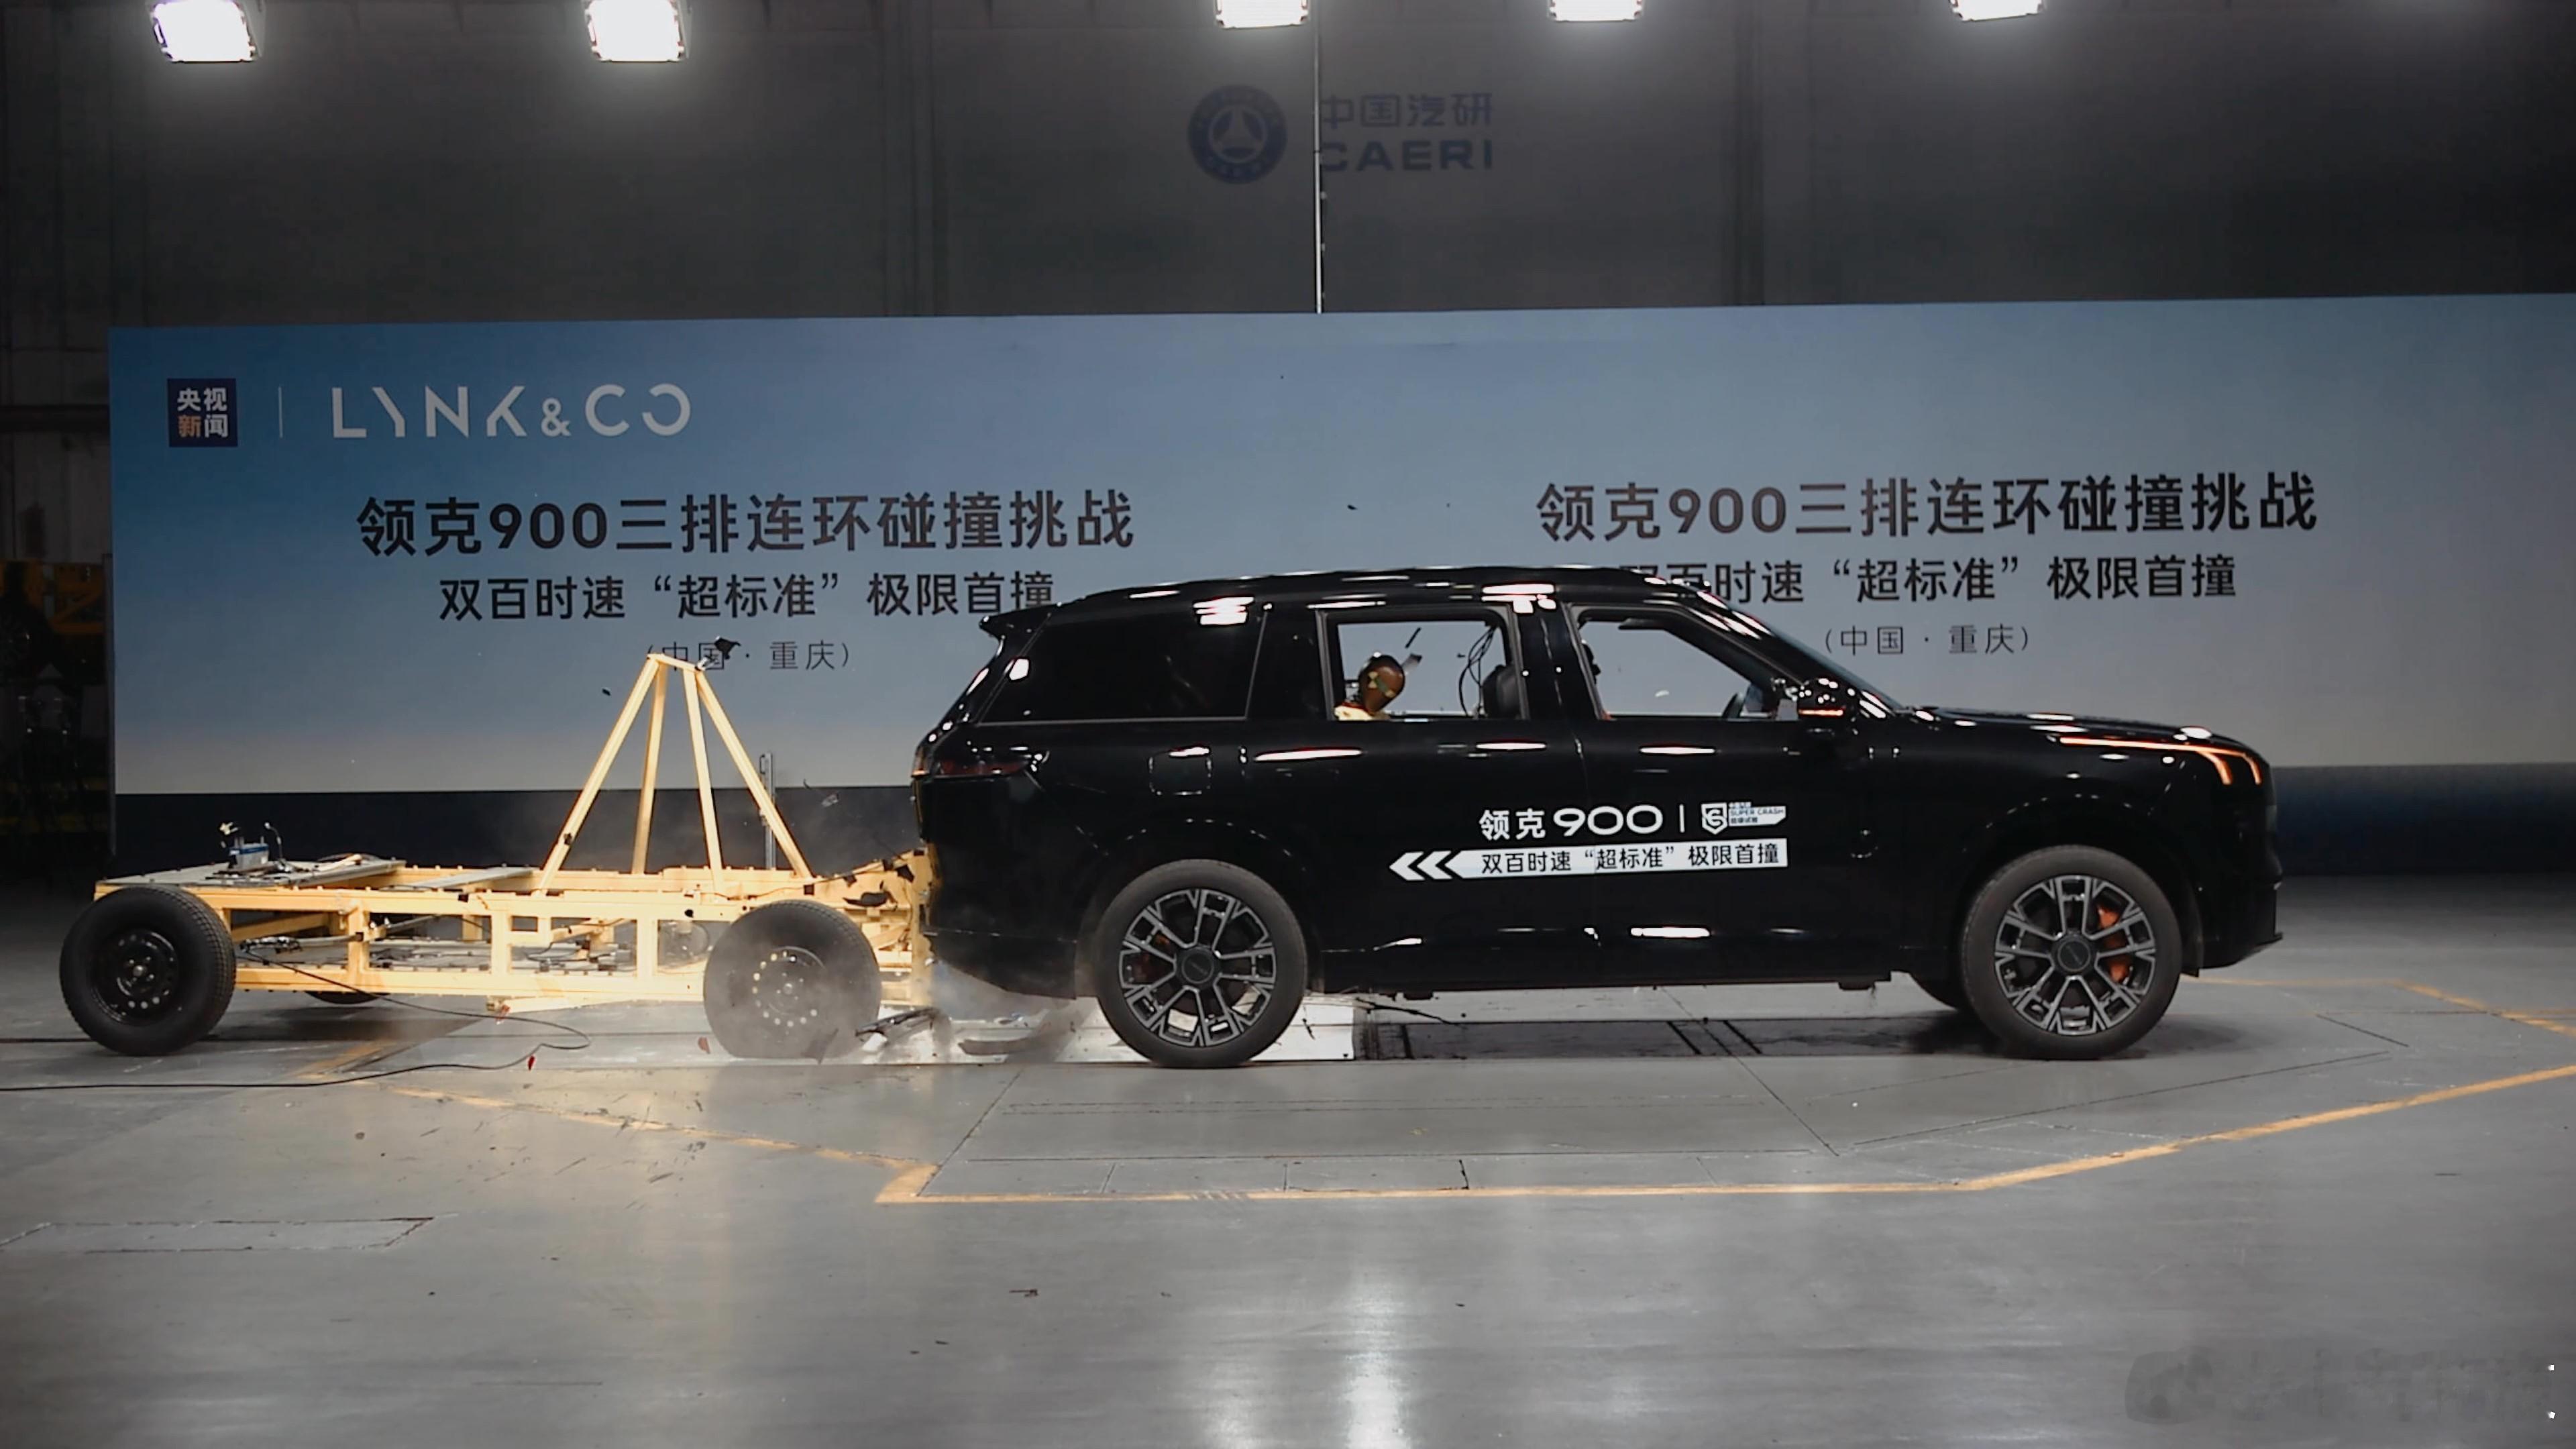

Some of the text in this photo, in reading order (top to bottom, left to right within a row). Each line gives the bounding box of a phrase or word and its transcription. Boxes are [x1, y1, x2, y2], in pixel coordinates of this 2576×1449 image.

[1321, 92, 1494, 129] 中国汽研
[1321, 139, 1493, 172] CAERI
[177, 387, 227, 411] 央视
[178, 414, 228, 438] 新闻
[356, 489, 1134, 557] 领克900三排连环碰撞挑战
[1536, 472, 2317, 542] 领克900三排连环碰撞挑战
[1479, 804, 1664, 841] 领克900
